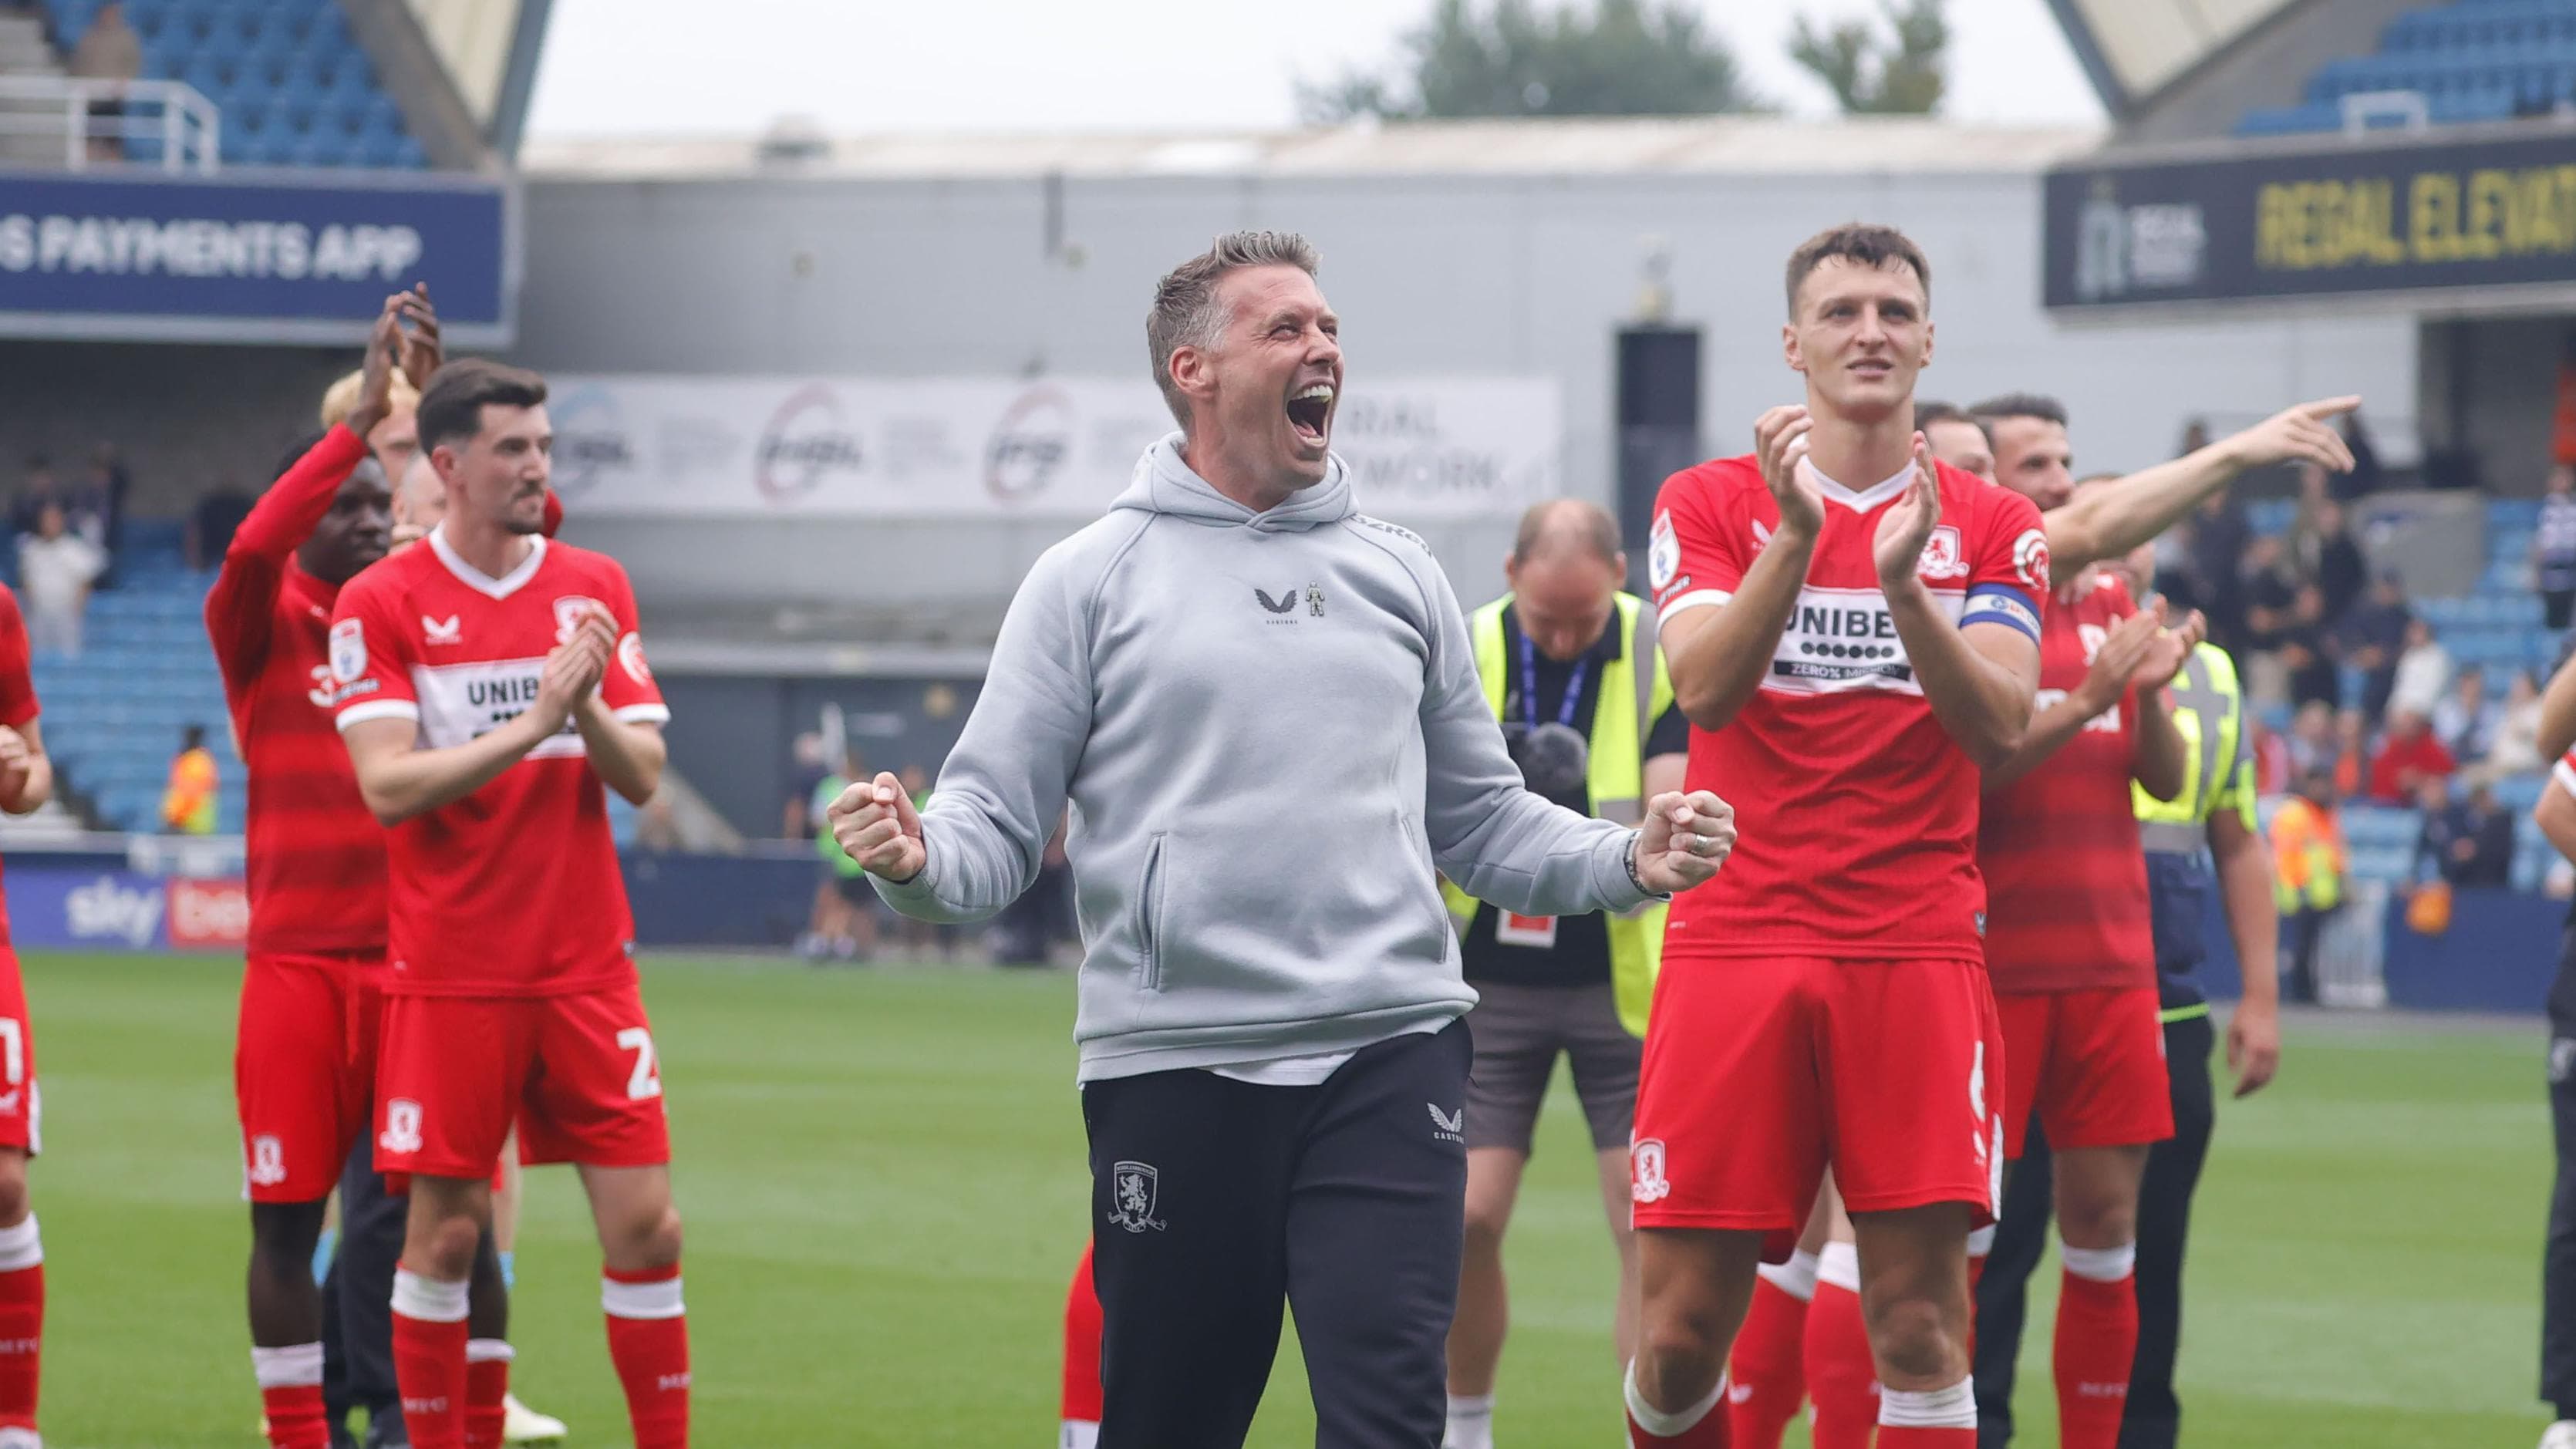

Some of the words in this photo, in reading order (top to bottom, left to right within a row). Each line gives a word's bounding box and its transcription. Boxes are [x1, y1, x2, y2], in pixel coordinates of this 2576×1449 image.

[39, 215, 309, 279] PAYMENTS
[313, 224, 423, 281] APP
[1790, 662, 1841, 679] ZERO%
[66, 878, 163, 948] sky
[617, 1027, 662, 1100] 2
